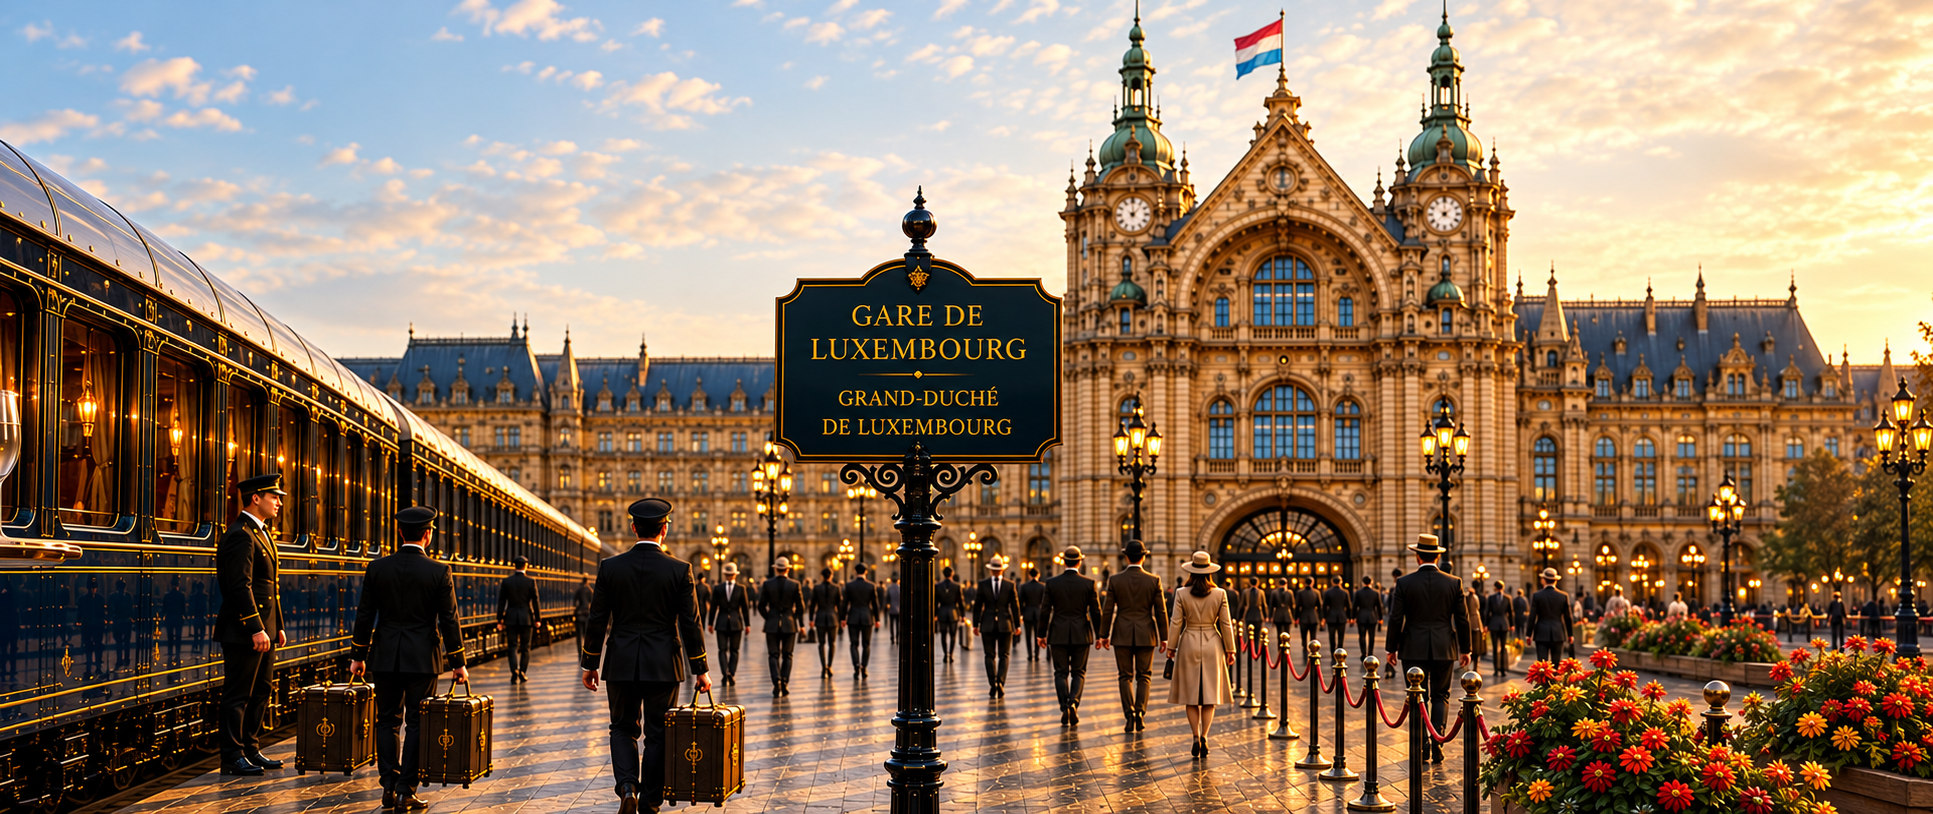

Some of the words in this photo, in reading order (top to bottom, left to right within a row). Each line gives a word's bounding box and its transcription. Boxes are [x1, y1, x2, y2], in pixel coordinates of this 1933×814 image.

[852, 305, 933, 326] GARE
[944, 305, 983, 326] DE
[811, 338, 1026, 360] LUXEMBOURG
[839, 386, 998, 406] GRAND-DUCHÉ
[823, 419, 850, 435] DE
[858, 419, 1011, 435] LUXEMBOURG
